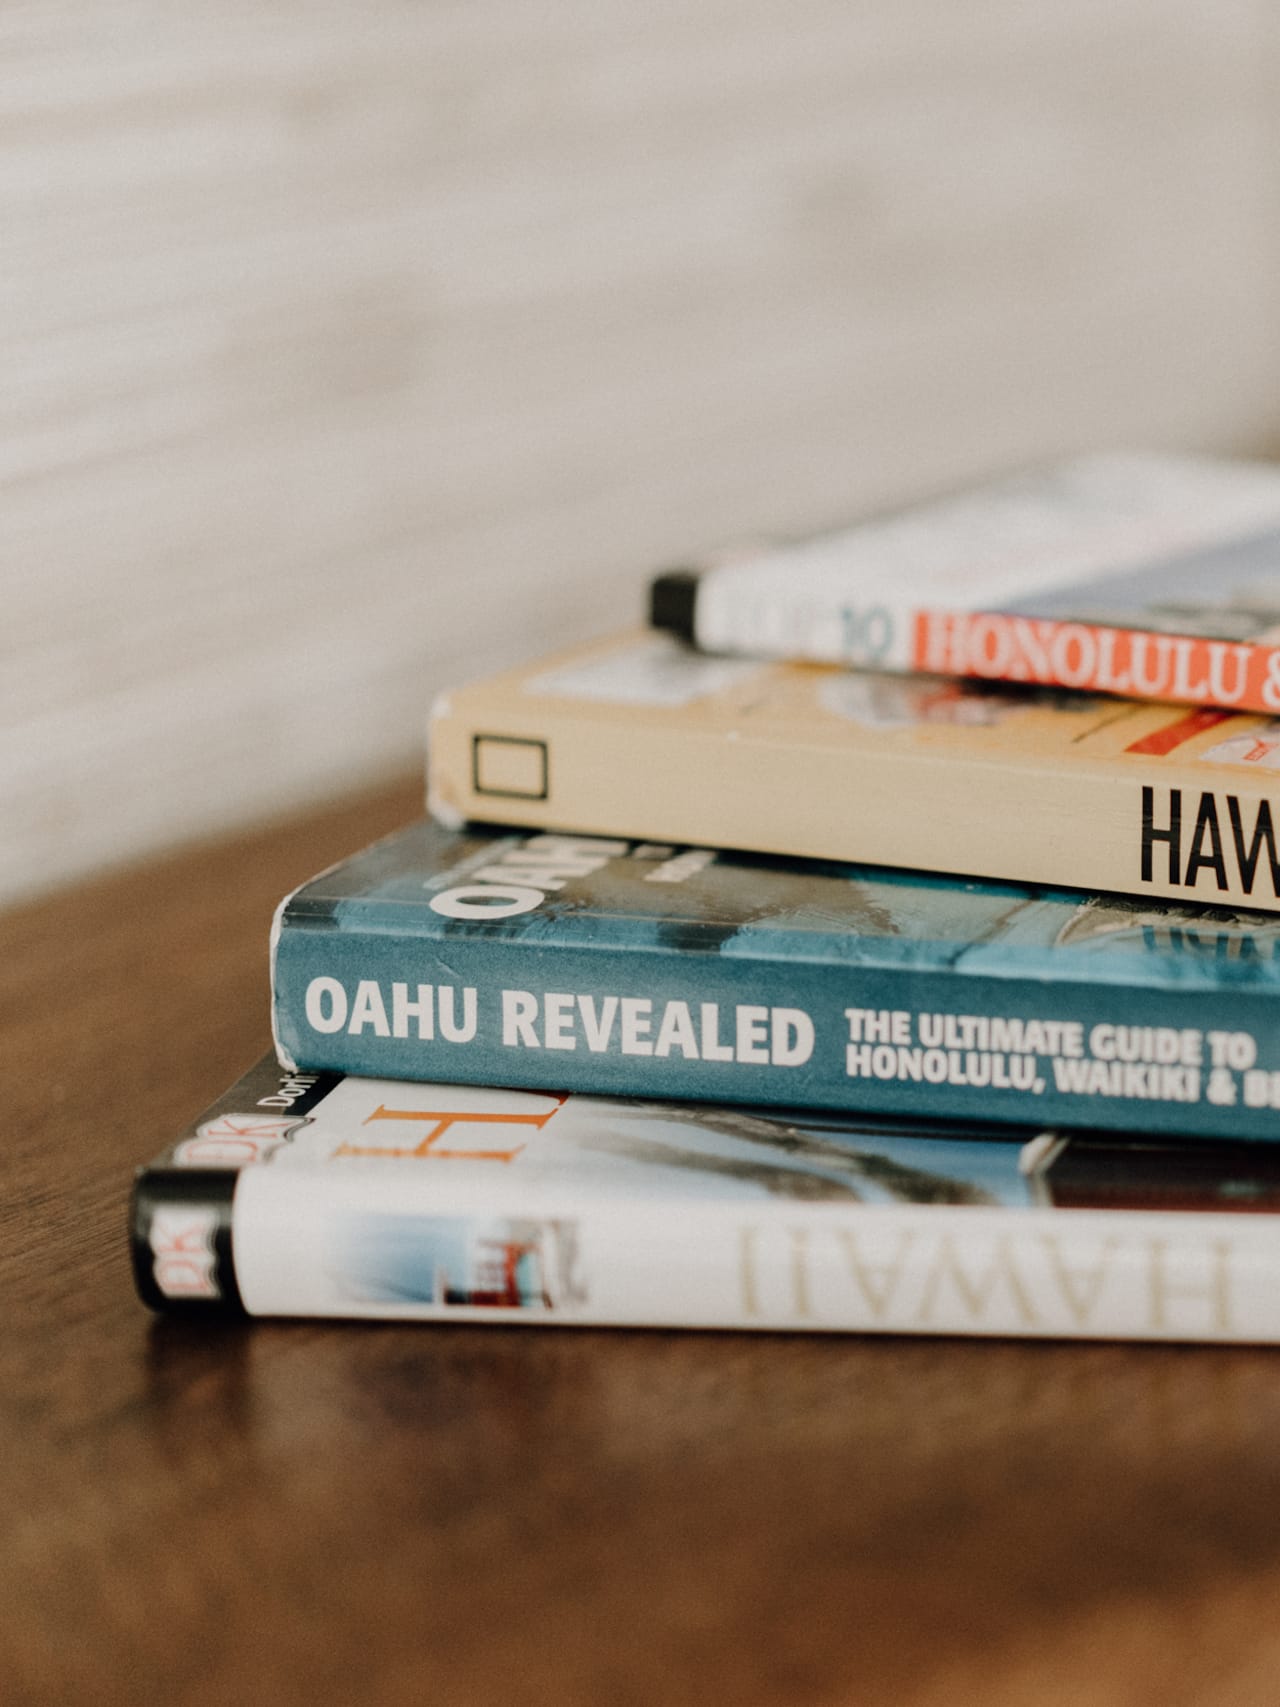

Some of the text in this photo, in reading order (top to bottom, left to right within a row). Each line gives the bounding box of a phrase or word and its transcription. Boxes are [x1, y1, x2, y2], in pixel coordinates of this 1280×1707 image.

[922, 610, 1251, 702] HONOLULU
[429, 835, 628, 920] OAH
[304, 976, 816, 1067] OAHU REVEALED
[844, 1008, 1256, 1072] THE ULTIMATE GUIDE TO
[256, 1073, 321, 1107] Dorli
[845, 1043, 1046, 1095] HONOLULU,
[1053, 1057, 1199, 1104] WAIKIKI
[1206, 1068, 1237, 1107] &
[738, 1225, 1237, 1333] HAWAII
